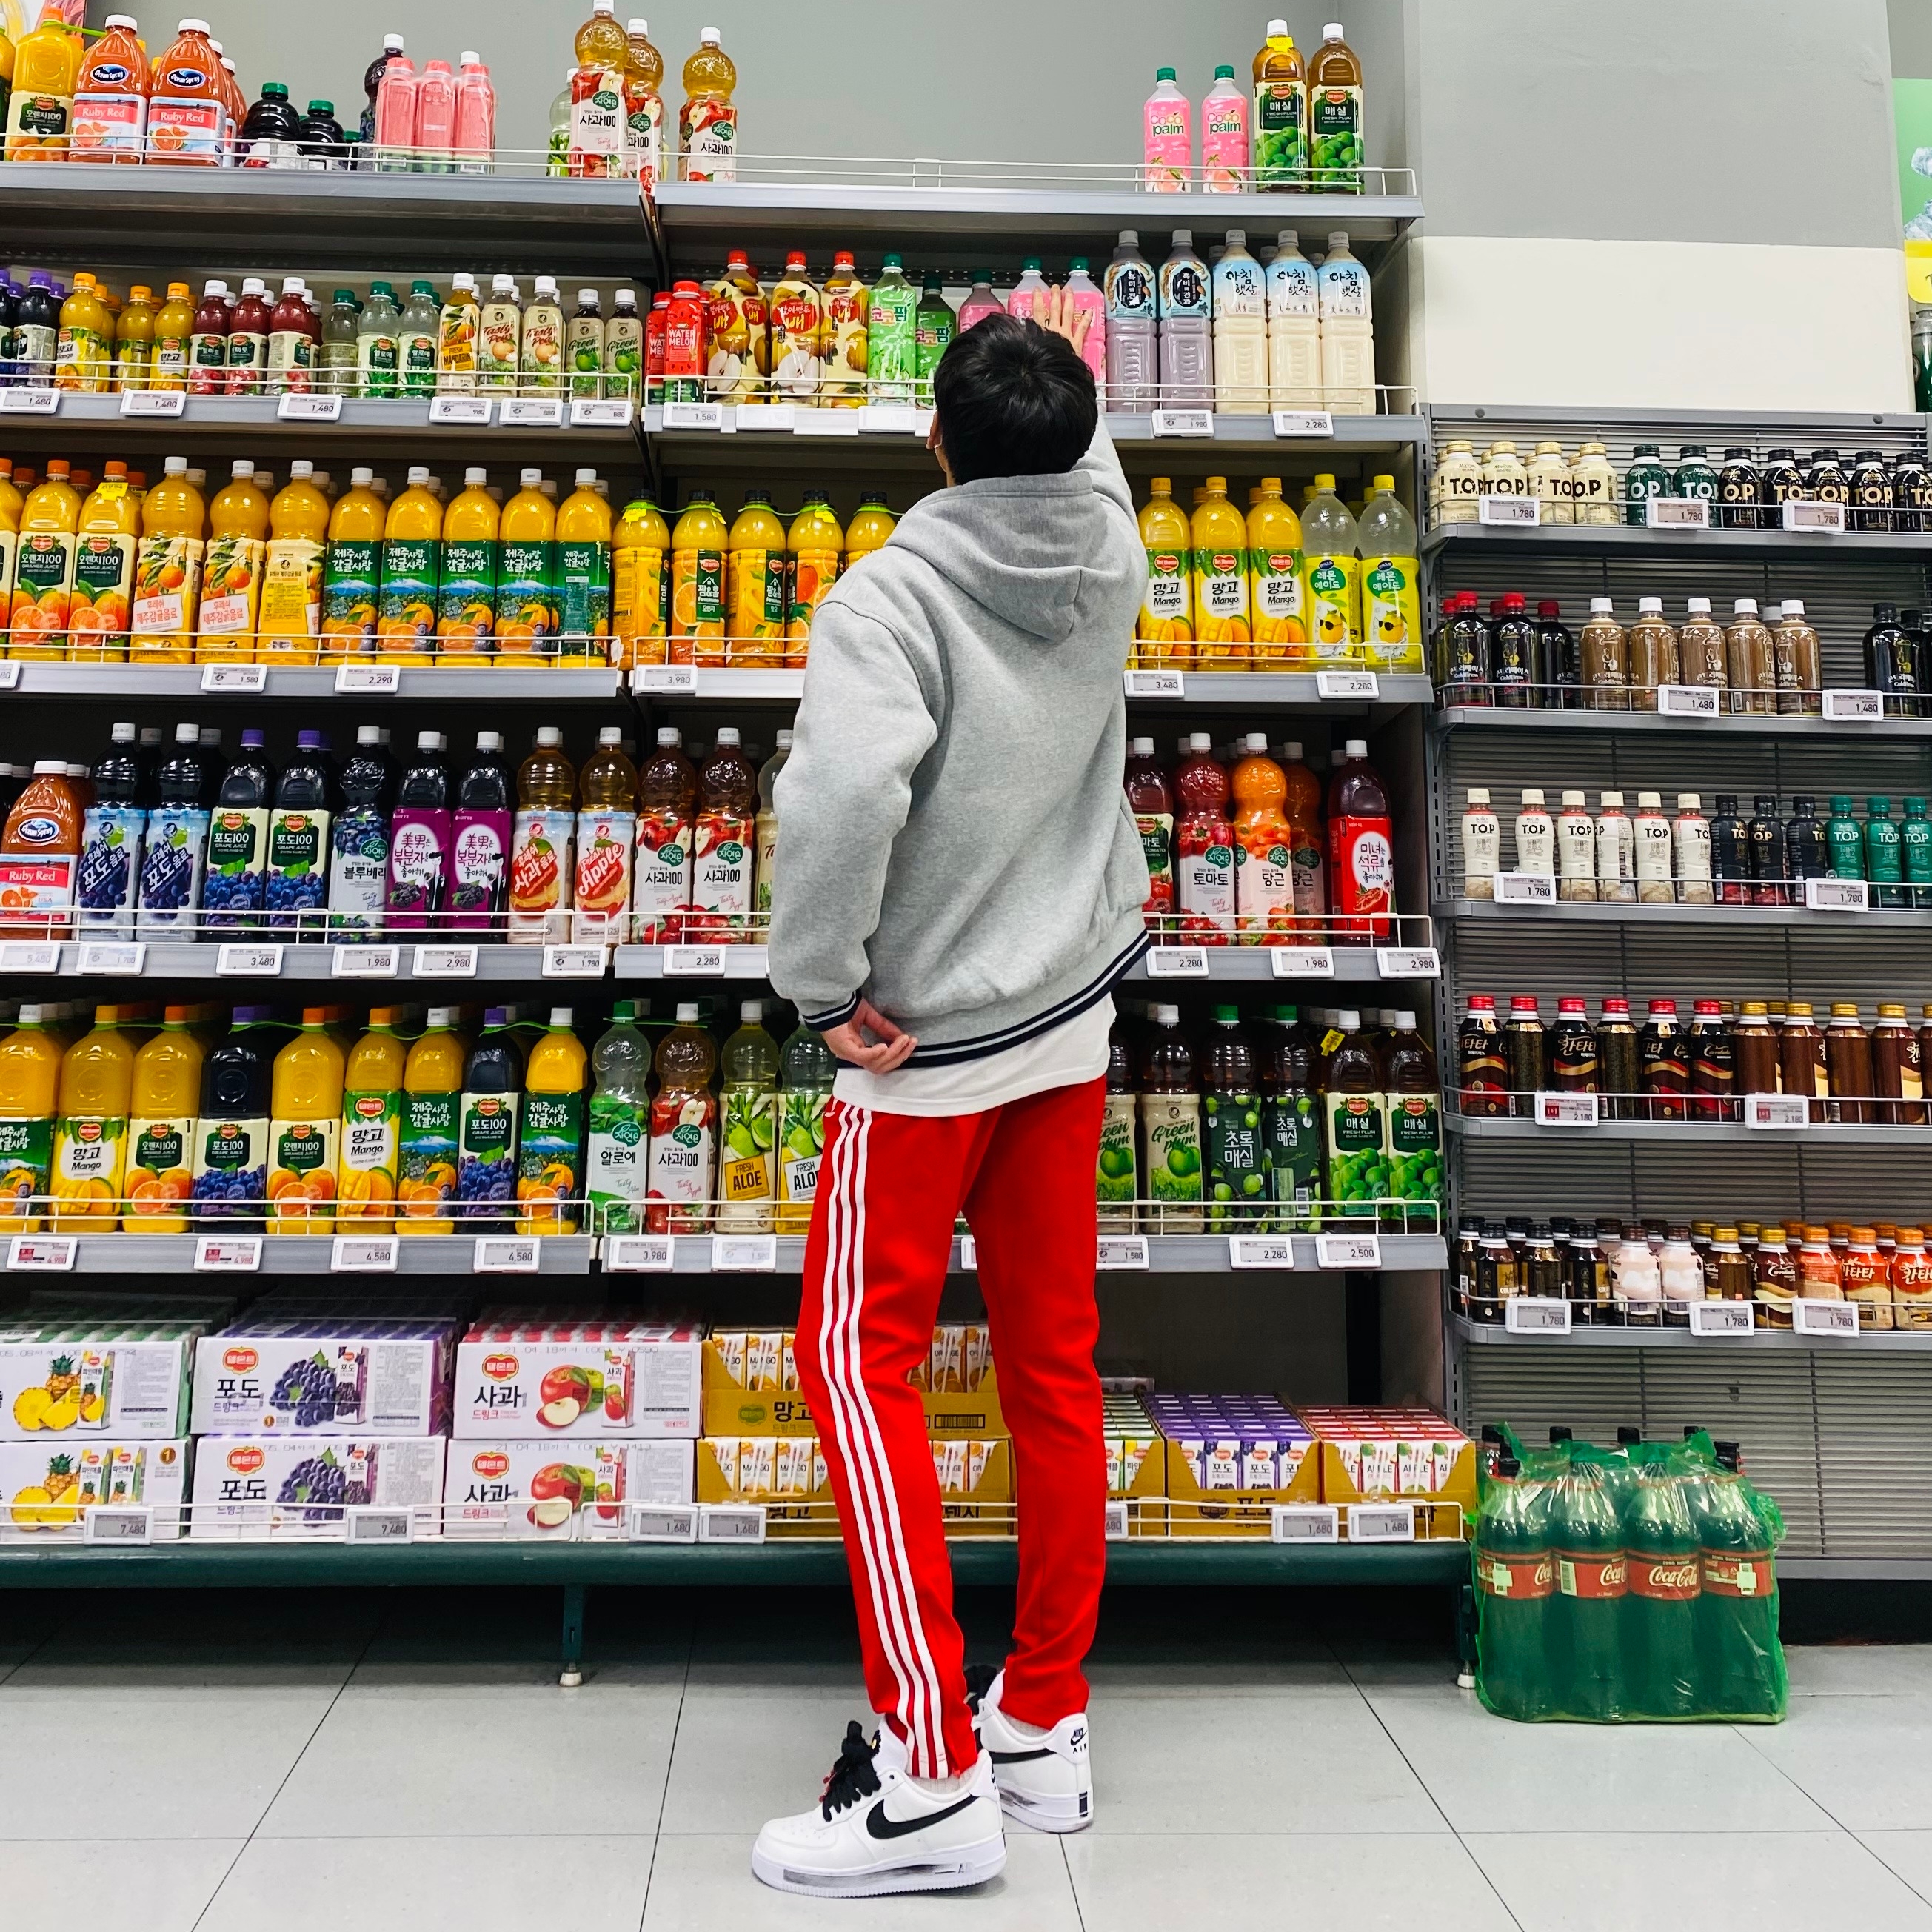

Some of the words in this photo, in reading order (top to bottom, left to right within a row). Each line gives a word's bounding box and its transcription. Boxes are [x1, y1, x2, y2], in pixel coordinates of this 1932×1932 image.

[594, 96, 619, 109] 자연은
[1269, 101, 1291, 111] 매실
[25, 110, 61, 120] 오렌지100
[82, 107, 104, 119] Ruby
[106, 107, 126, 118] Red
[160, 110, 183, 124] Ruby
[184, 112, 204, 123] Red
[1324, 105, 1346, 116] 매실
[579, 113, 616, 127] 사과100
[1152, 124, 1184, 137] palm
[1209, 121, 1241, 135] palm
[1226, 270, 1253, 285] 아침
[1277, 270, 1306, 285] 아침
[1330, 271, 1359, 286] 아침
[1236, 284, 1259, 298] 햇살
[871, 303, 912, 324] 코코팜
[482, 323, 513, 336] Tasty
[668, 329, 695, 338] WATER
[915, 326, 951, 344] 코코팜
[567, 338, 598, 352] Green
[606, 338, 638, 352] Green
[668, 336, 695, 347] MELON
[21, 553, 61, 566] 오렌지100
[333, 547, 371, 560] 제주사랑
[447, 548, 484, 560] 제주사랑
[332, 559, 373, 572] 감귤사랑
[445, 559, 487, 572] 감귤사랑
[1317, 570, 1337, 582] 레몬
[1153, 582, 1181, 595] 망고
[1211, 581, 1239, 595] 망고
[1314, 579, 1341, 590] 에이드
[1153, 596, 1182, 609] Mango
[1211, 595, 1240, 607] Mango
[1470, 824, 1495, 834] T.O.P
[1522, 825, 1545, 835] T.O.P
[1645, 828, 1668, 838] T.O.P
[214, 832, 250, 844] 포도100
[276, 833, 312, 846] 포도100
[1834, 832, 1859, 842] T.O.P
[362, 844, 386, 858] 자연은
[580, 846, 604, 869] Fresh
[660, 851, 683, 863] 자연은
[539, 852, 557, 870] 음료
[82, 860, 113, 893] 포도
[109, 847, 127, 869] 음료
[344, 866, 387, 880] 블루베리
[400, 866, 424, 878] 좋아해
[578, 842, 624, 897] Apple
[703, 869, 741, 883] 사과100
[8, 870, 34, 884] Ruby
[36, 870, 56, 882] Red
[513, 863, 541, 892] 사과
[645, 871, 683, 885] 사과100
[1193, 872, 1229, 886] 토마토
[1262, 872, 1286, 887] 당근
[411, 1101, 450, 1114] 제주사랑
[410, 1113, 452, 1129] 감귤사랑
[471, 1118, 507, 1131] 포도100
[1276, 1117, 1298, 1132] 초록
[1346, 1117, 1371, 1130] 매실
[1403, 1118, 1428, 1130] 매실
[352, 1128, 384, 1144] 망고
[614, 1130, 641, 1143] 자연은
[1151, 1122, 1197, 1143] Green
[1223, 1129, 1254, 1149] 초록
[1276, 1131, 1299, 1147] 매실
[141, 1140, 177, 1151] 오렌지100
[211, 1140, 244, 1151] 포도100
[1163, 1133, 1197, 1154] plum
[73, 1147, 101, 1160] 망고
[350, 1145, 384, 1157] Mango
[601, 1151, 637, 1166] 알로에
[658, 1152, 699, 1167] 사과100
[1223, 1149, 1254, 1169] 매실
[70, 1160, 101, 1171] Mango
[735, 1161, 755, 1172] FRESH
[795, 1162, 815, 1173] FRESH
[732, 1170, 763, 1191] ALOE
[215, 1378, 261, 1399] 포도
[474, 1385, 521, 1408] 사과
[472, 1409, 499, 1420] 드링크
[1211, 1463, 1233, 1474] 포도
[1249, 1463, 1271, 1475] 포도
[218, 1478, 267, 1501] 포도
